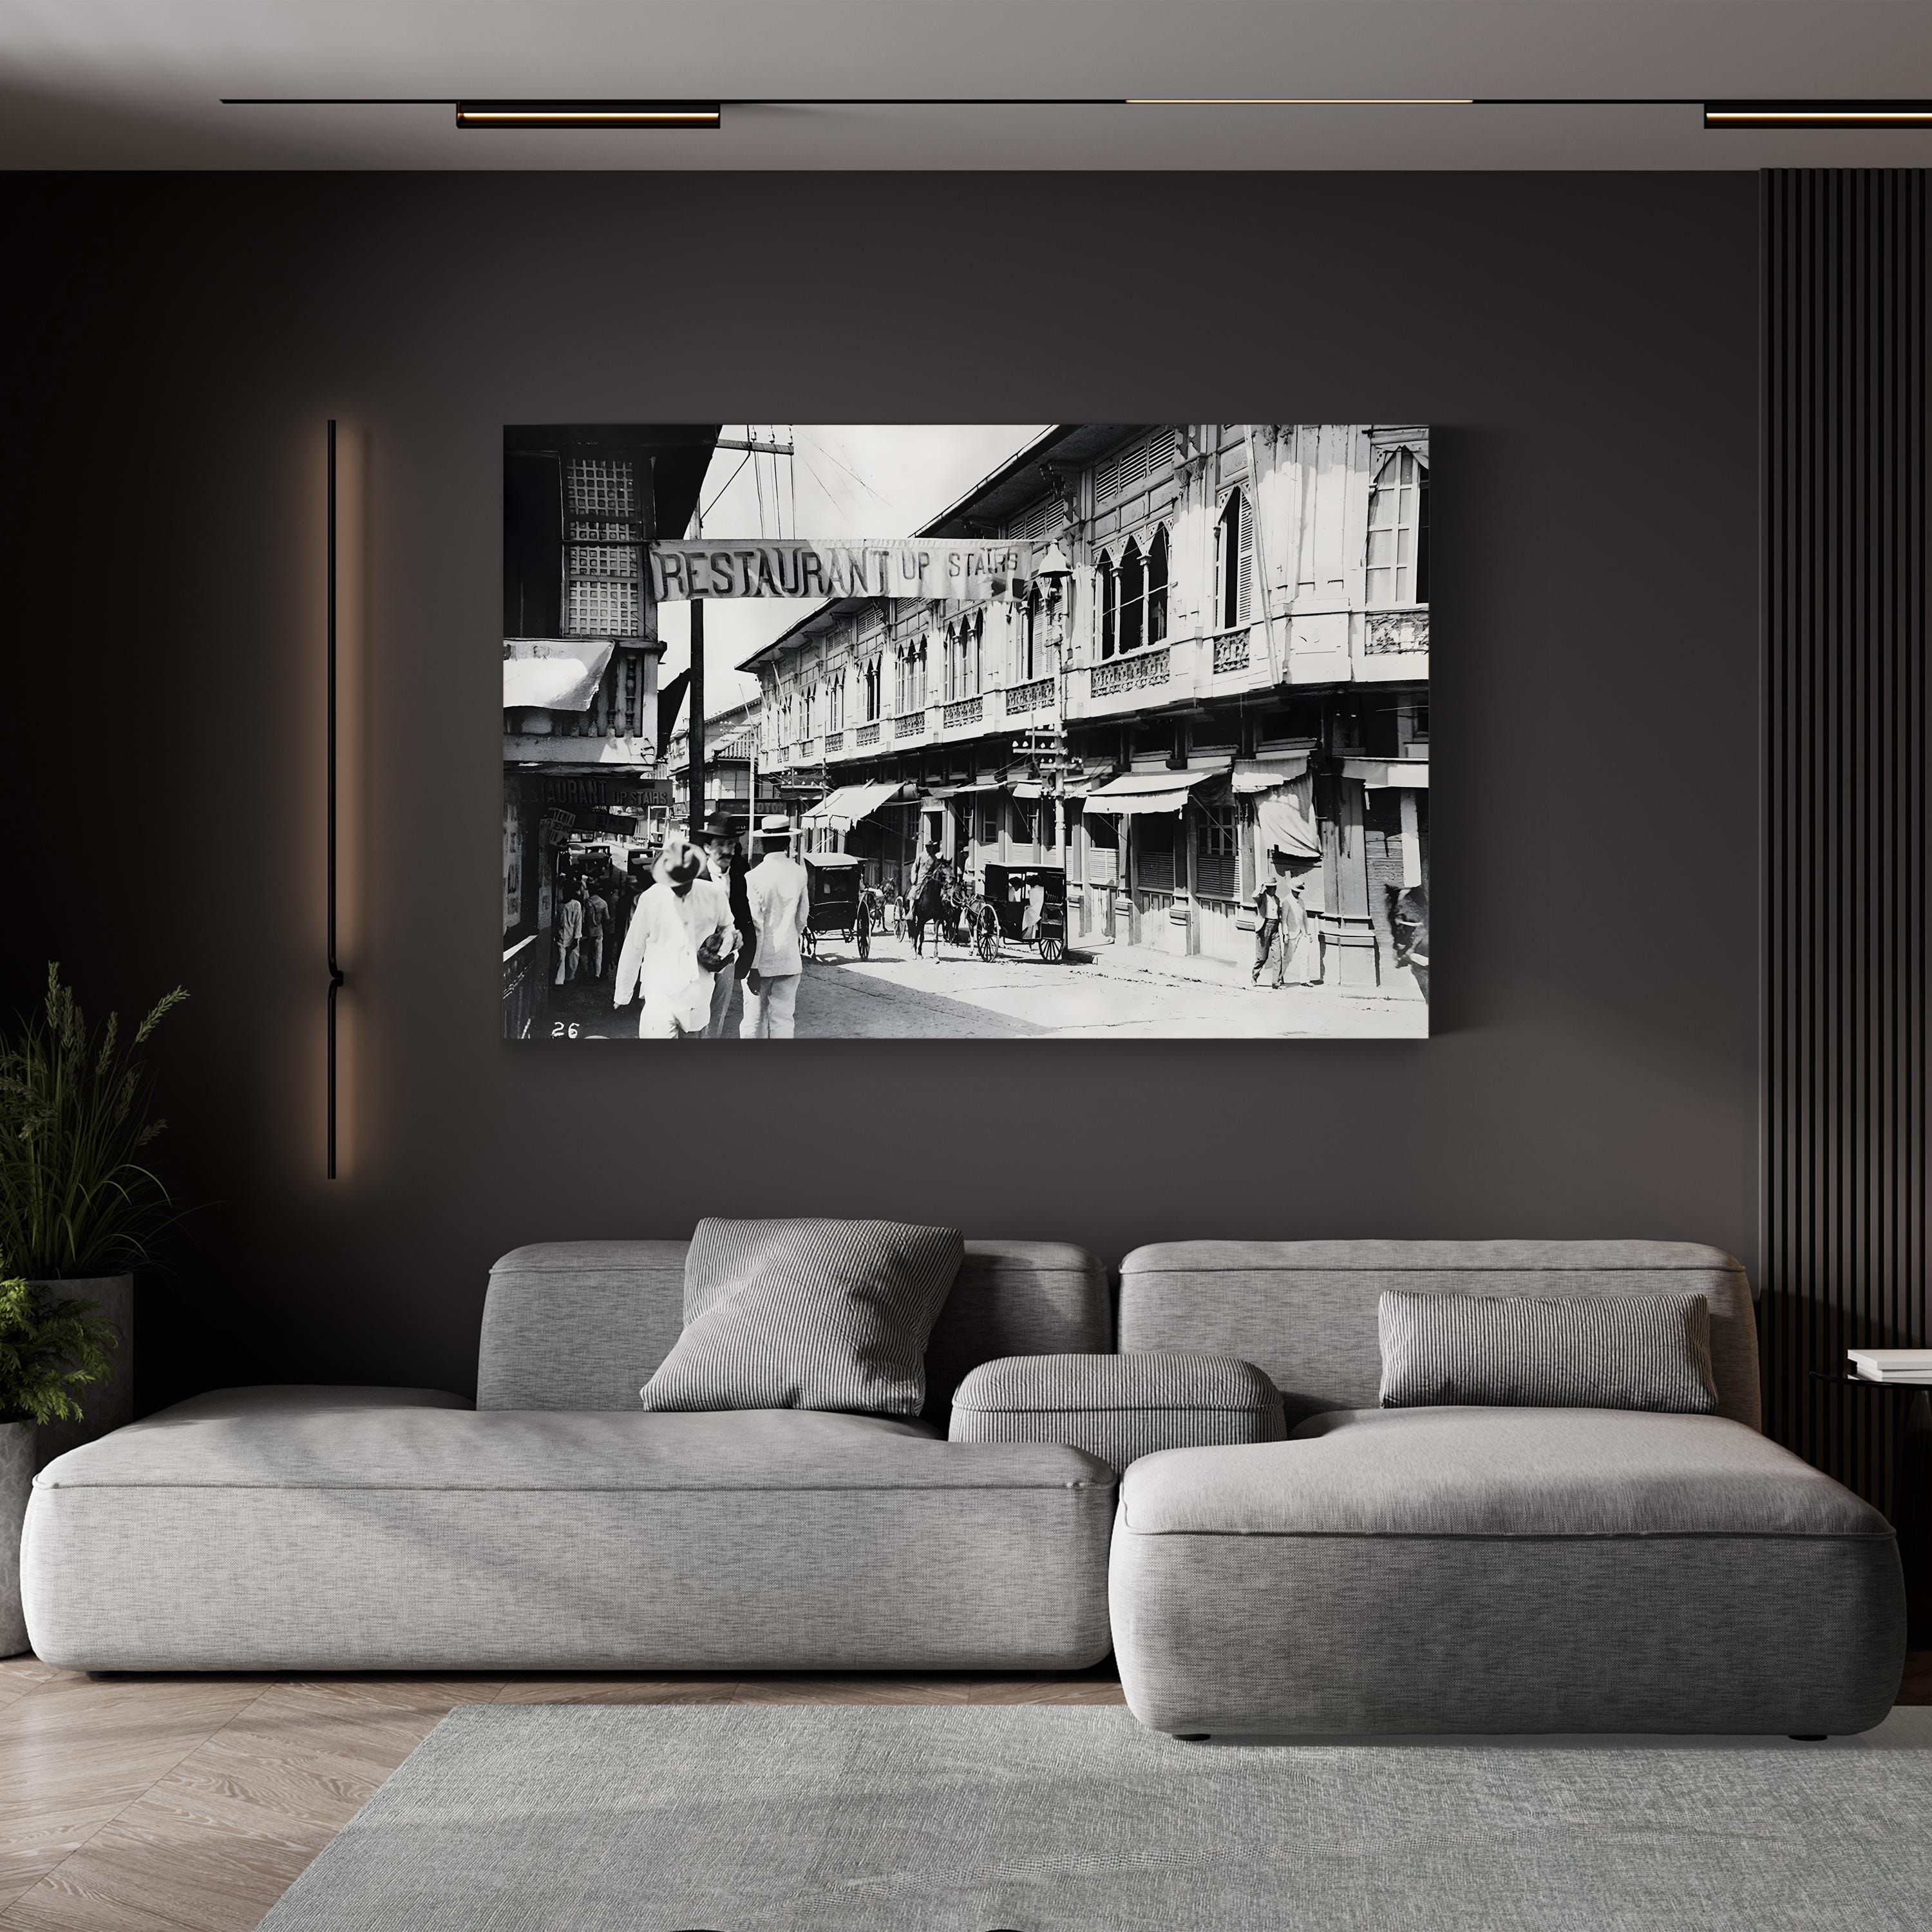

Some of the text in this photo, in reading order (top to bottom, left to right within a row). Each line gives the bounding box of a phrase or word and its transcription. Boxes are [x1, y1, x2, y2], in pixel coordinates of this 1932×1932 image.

[652, 547, 889, 601] RESTAURANT
[902, 551, 930, 580] UP
[612, 791, 628, 805] UP
[630, 791, 668, 805] STAIRS
[551, 1021, 580, 1039] 26
